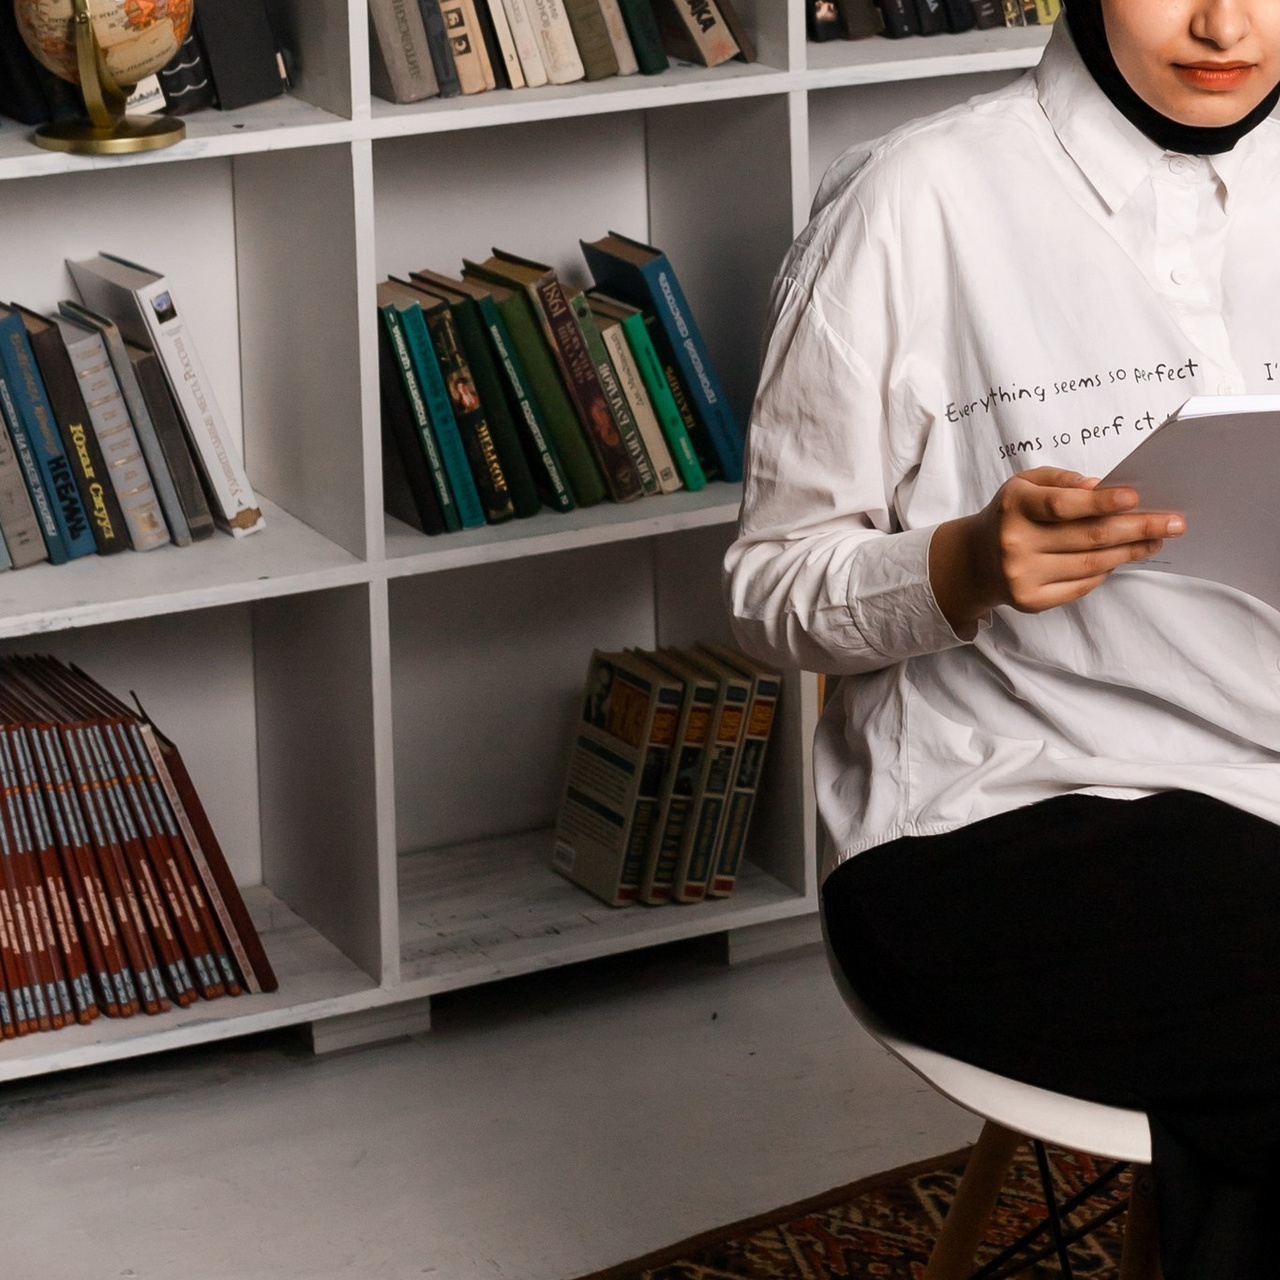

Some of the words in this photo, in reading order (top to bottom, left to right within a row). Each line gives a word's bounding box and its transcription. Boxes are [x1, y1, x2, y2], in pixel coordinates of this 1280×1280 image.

[540, 280, 568, 318] 1861
[656, 269, 690, 338] СЕВАСТОПОЛЬ
[390, 323, 411, 370] ЦЕЛИНА
[403, 368, 428, 426] ПОДНЯТАЯ
[945, 384, 1045, 422] Everything
[1054, 373, 1101, 395] seems
[1109, 368, 1126, 383] so
[1134, 358, 1199, 384] perfect
[999, 437, 1043, 459] seems
[1053, 432, 1071, 448] so
[1081, 411, 1155, 445] perfct
[67, 420, 99, 480] Юхан
[84, 480, 118, 542] Смуул
